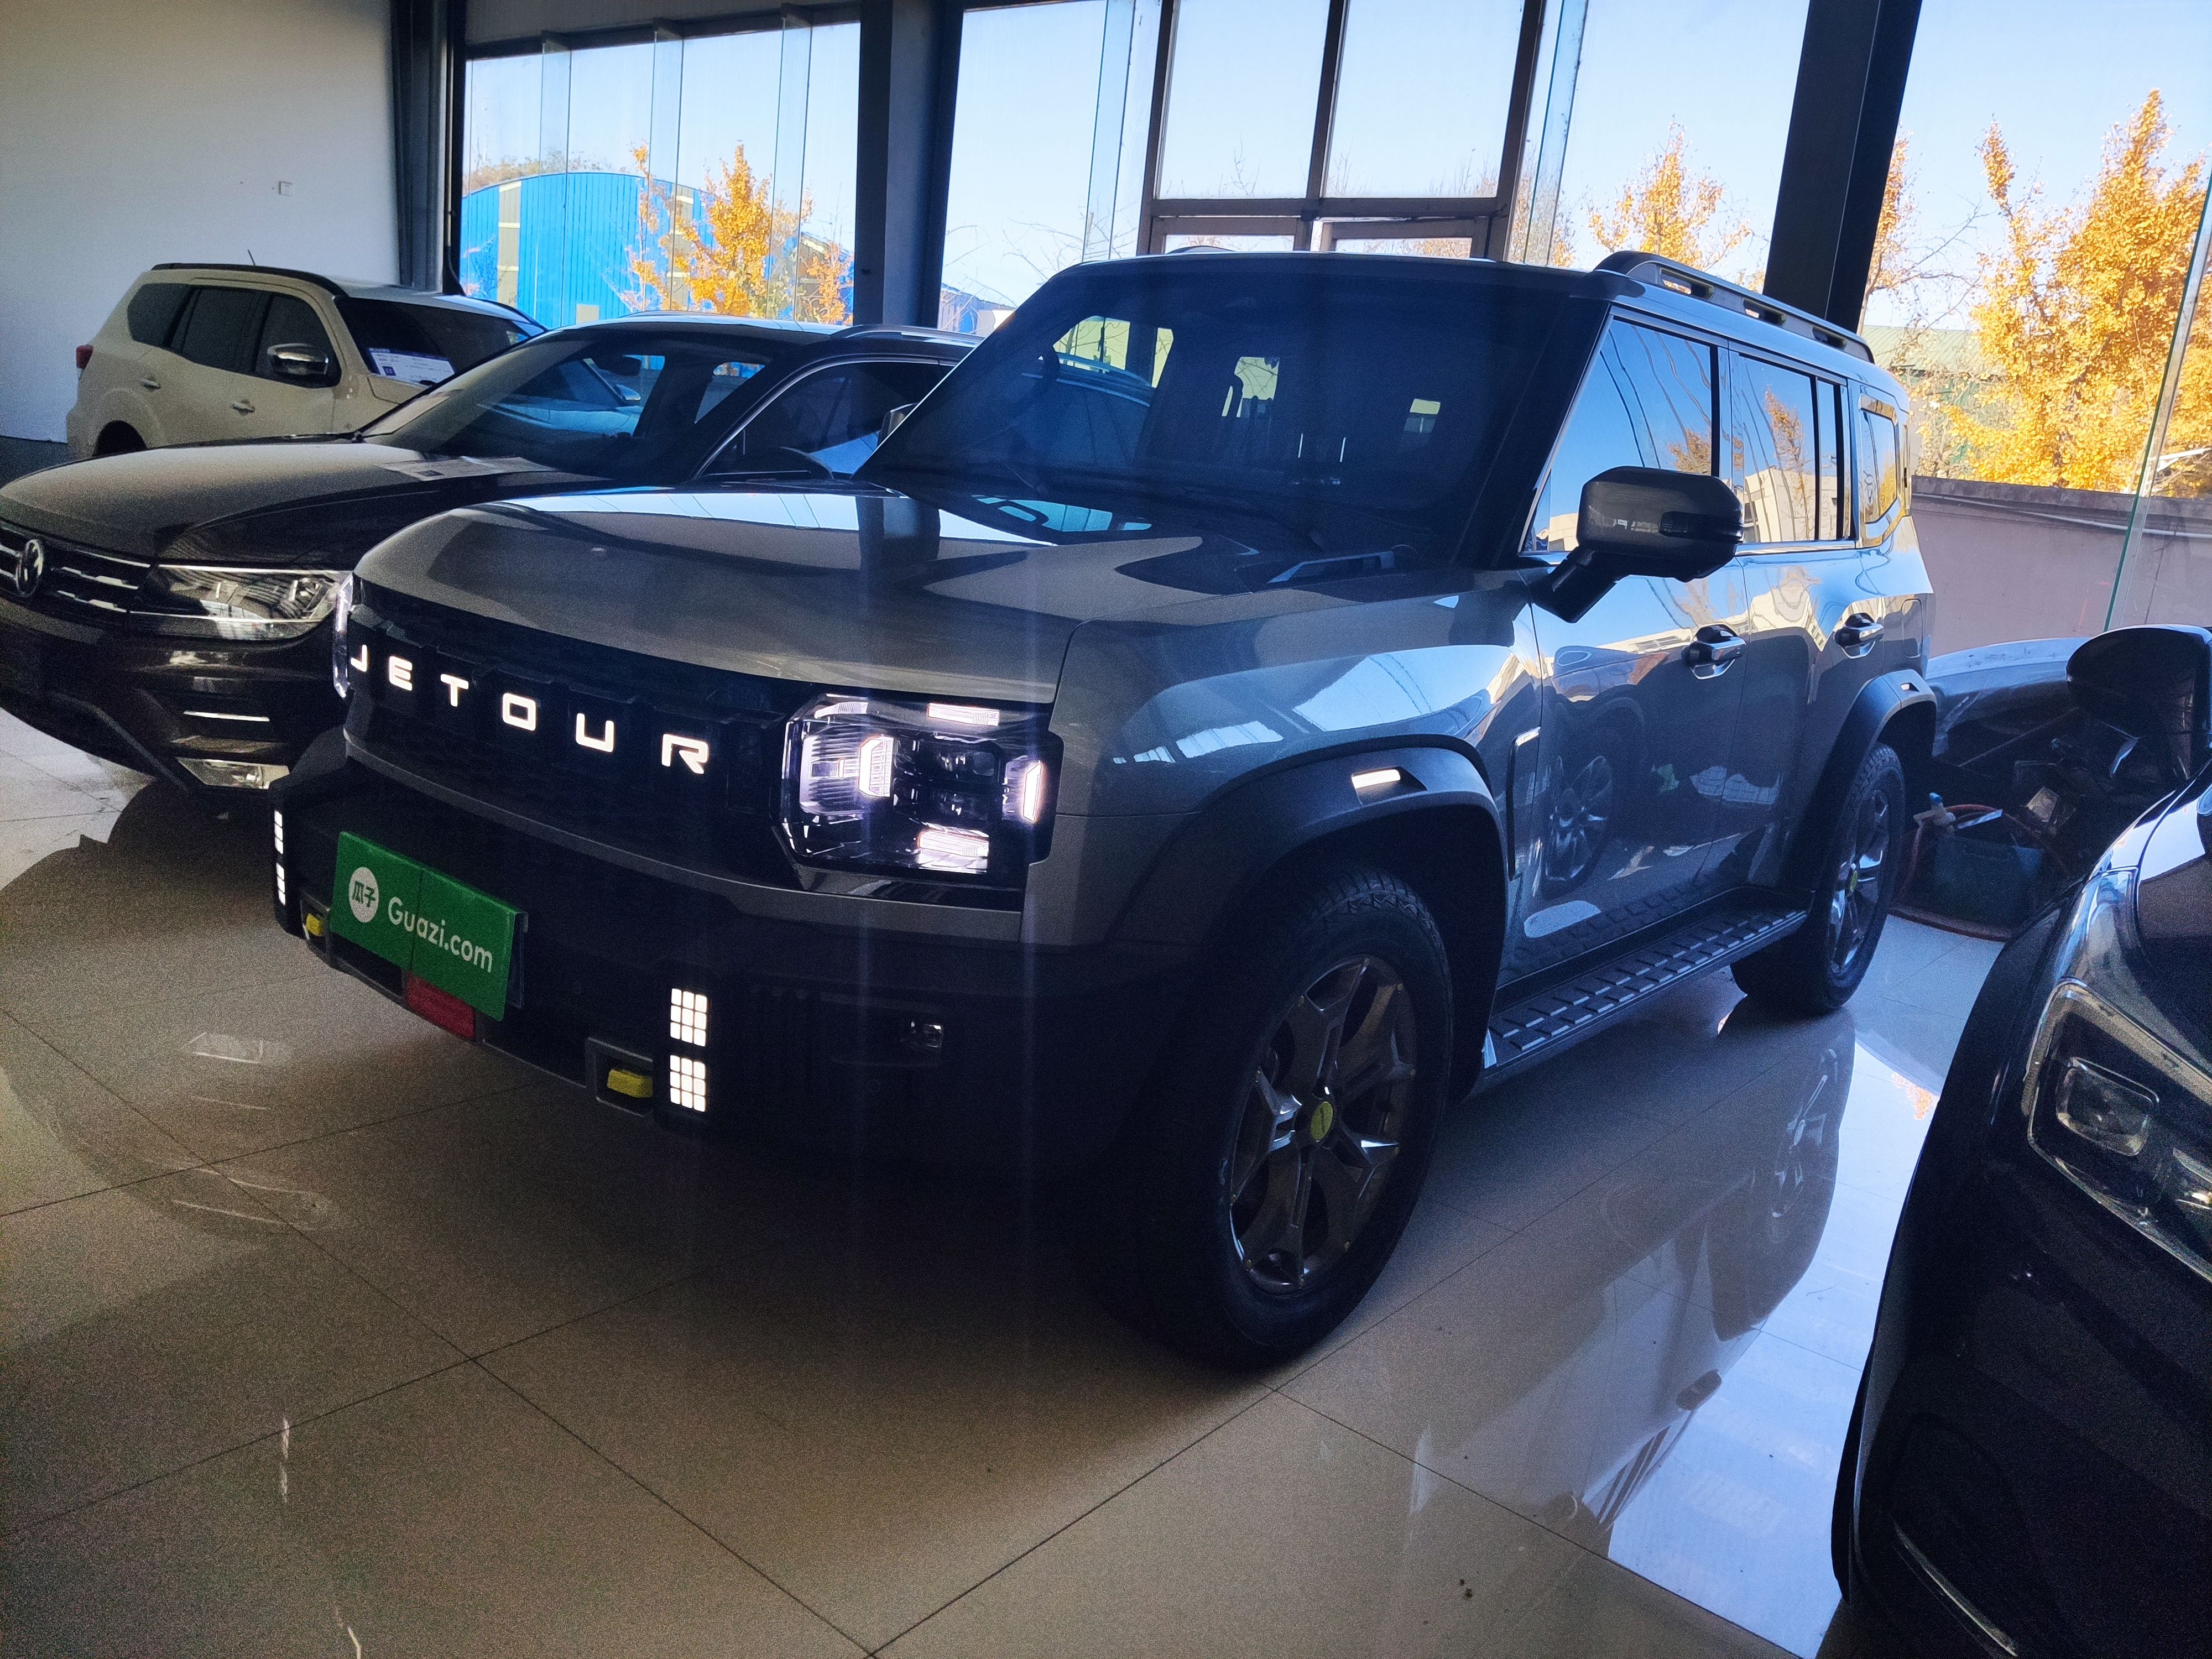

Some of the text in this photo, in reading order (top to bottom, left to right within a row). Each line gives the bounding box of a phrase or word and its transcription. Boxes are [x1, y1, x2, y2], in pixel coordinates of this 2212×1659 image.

[350, 644, 709, 774] JETOUR
[352, 881, 376, 908] 瓜子
[388, 896, 493, 973] Guazi.com
